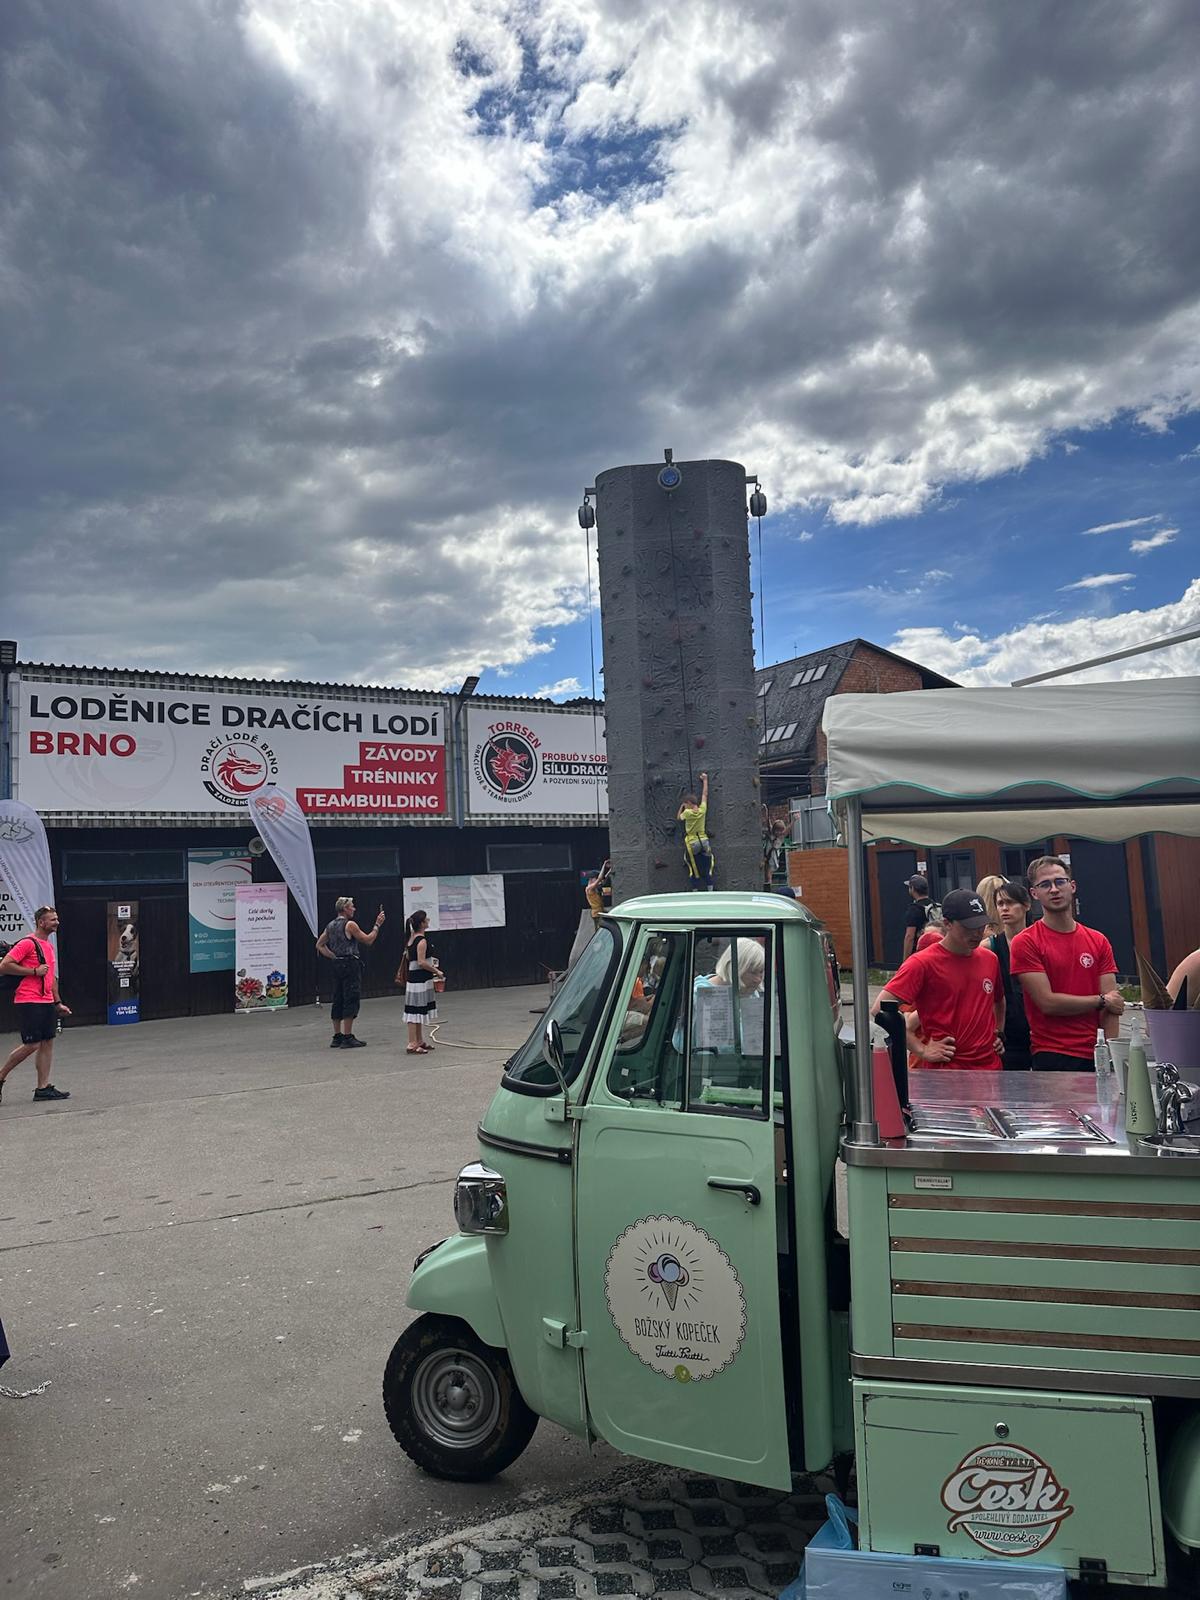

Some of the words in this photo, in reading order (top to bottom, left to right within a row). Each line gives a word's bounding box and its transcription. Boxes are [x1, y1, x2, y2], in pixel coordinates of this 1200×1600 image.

[30, 692, 211, 726] LODĚNICE
[222, 704, 362, 733] DRAČÍCH
[372, 712, 439, 737] LODÍ
[30, 730, 137, 757] BRNO
[487, 721, 542, 749] TORRSEN
[201, 736, 223, 772] DRAČÍ
[225, 732, 259, 744] LODĚ
[260, 743, 279, 774] BRNO
[364, 746, 438, 763] ZÁVODY
[542, 752, 580, 761] PROBUĎ
[351, 767, 438, 785] TRÉNINKY
[543, 762, 569, 775] SÍLU
[303, 793, 440, 809] TEAMBUILDING
[634, 1316, 671, 1338] BOŽSKÝ
[675, 1321, 721, 1344] KOPEČEK
[655, 1344, 679, 1360] Tutti
[678, 1346, 711, 1362] Frutti
[943, 1466, 1065, 1513] Cesk
[971, 1512, 1011, 1524] SPOLEHLIVÝ
[974, 1528, 1042, 1548] www.cesk.cz
